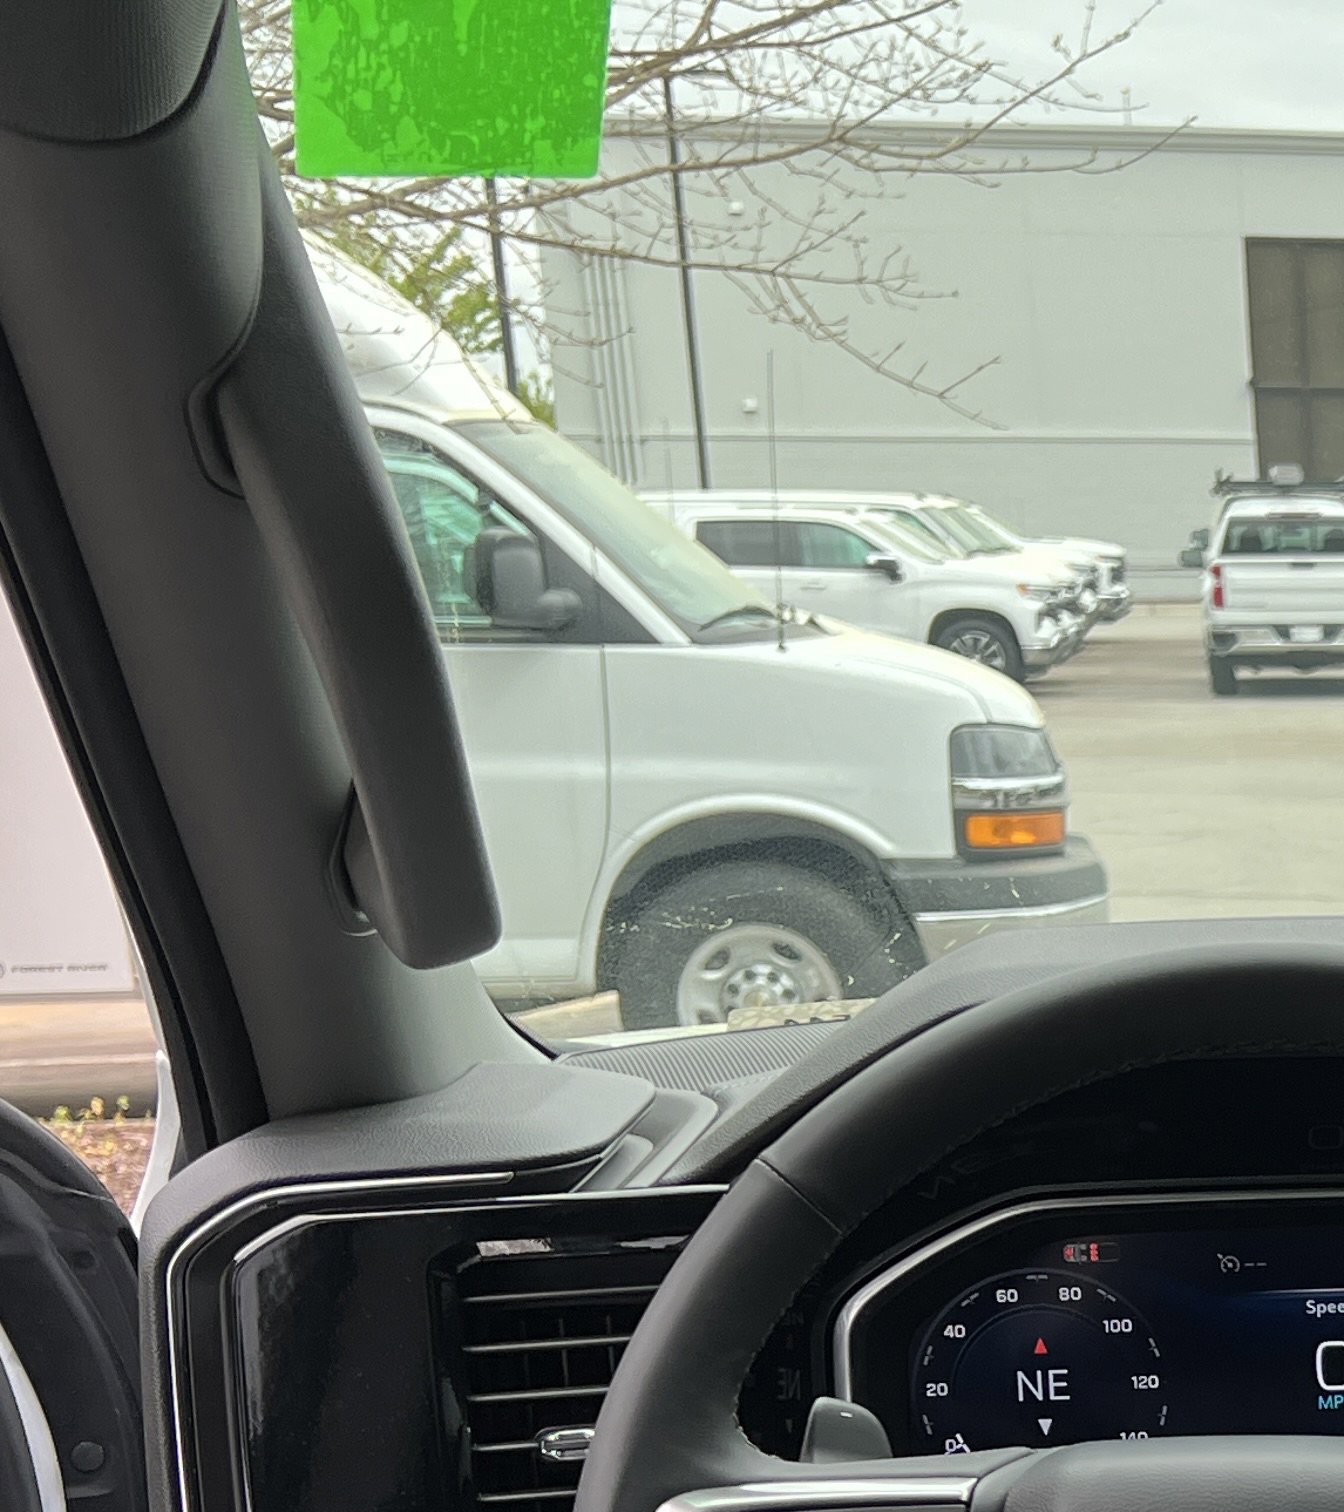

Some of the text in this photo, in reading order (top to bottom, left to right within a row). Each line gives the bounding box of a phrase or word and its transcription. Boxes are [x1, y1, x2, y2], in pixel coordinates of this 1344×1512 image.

[996, 1289, 1018, 1302] 60
[1058, 1287, 1082, 1301] 80
[944, 1325, 965, 1338] 40
[1102, 1319, 1133, 1333] 100
[1017, 1369, 1070, 1402] NE
[1131, 1375, 1159, 1389] 120
[926, 1383, 948, 1397] 20
